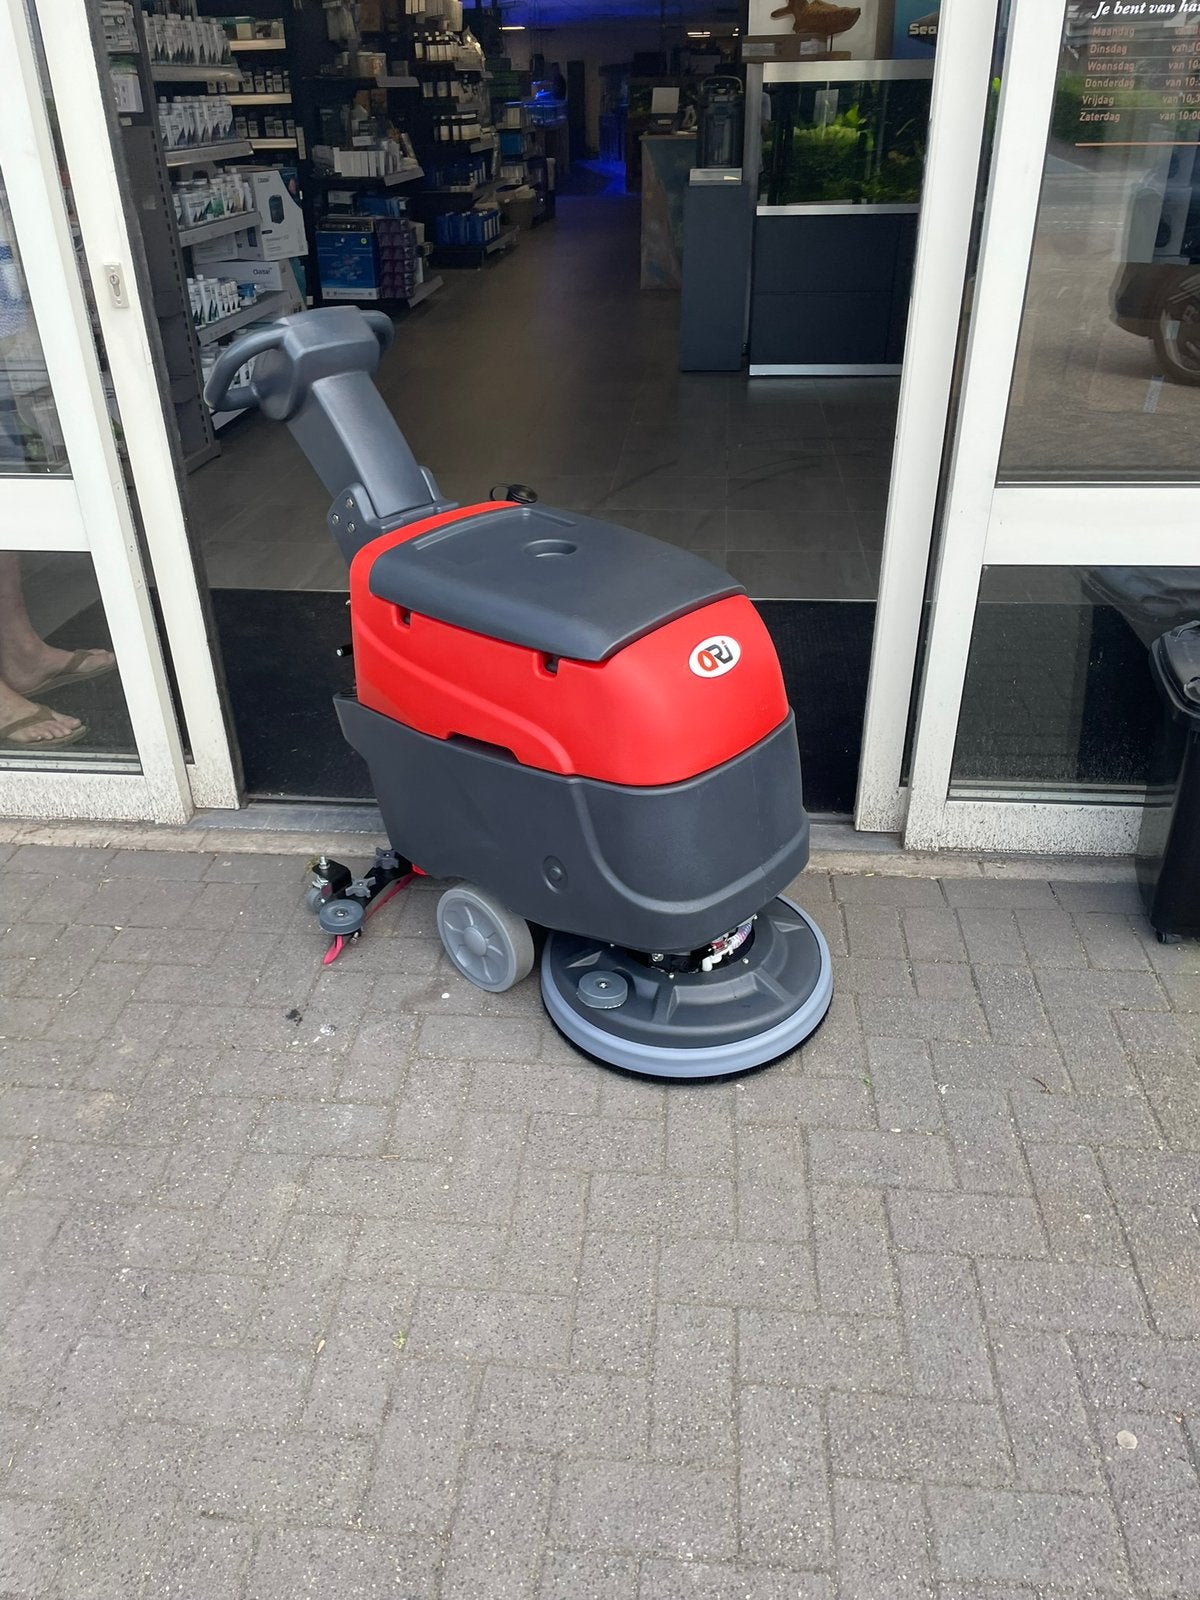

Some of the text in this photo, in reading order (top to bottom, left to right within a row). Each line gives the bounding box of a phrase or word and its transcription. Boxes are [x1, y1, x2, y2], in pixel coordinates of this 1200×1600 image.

[1091, 1, 1110, 19] Je
[1113, 1, 1145, 15] bent
[1149, 4, 1175, 14] van
[1093, 26, 1135, 38] Maandag
[1090, 43, 1127, 56] Dinsdag
[1088, 61, 1135, 73] Woensdag
[1168, 62, 1184, 70] van
[1085, 78, 1135, 90] Donderdag
[1165, 79, 1181, 87] van
[1082, 95, 1115, 107] Vrijdag
[1162, 95, 1178, 104] van
[1079, 112, 1121, 123] Zaterdag
[1159, 112, 1176, 120] van
